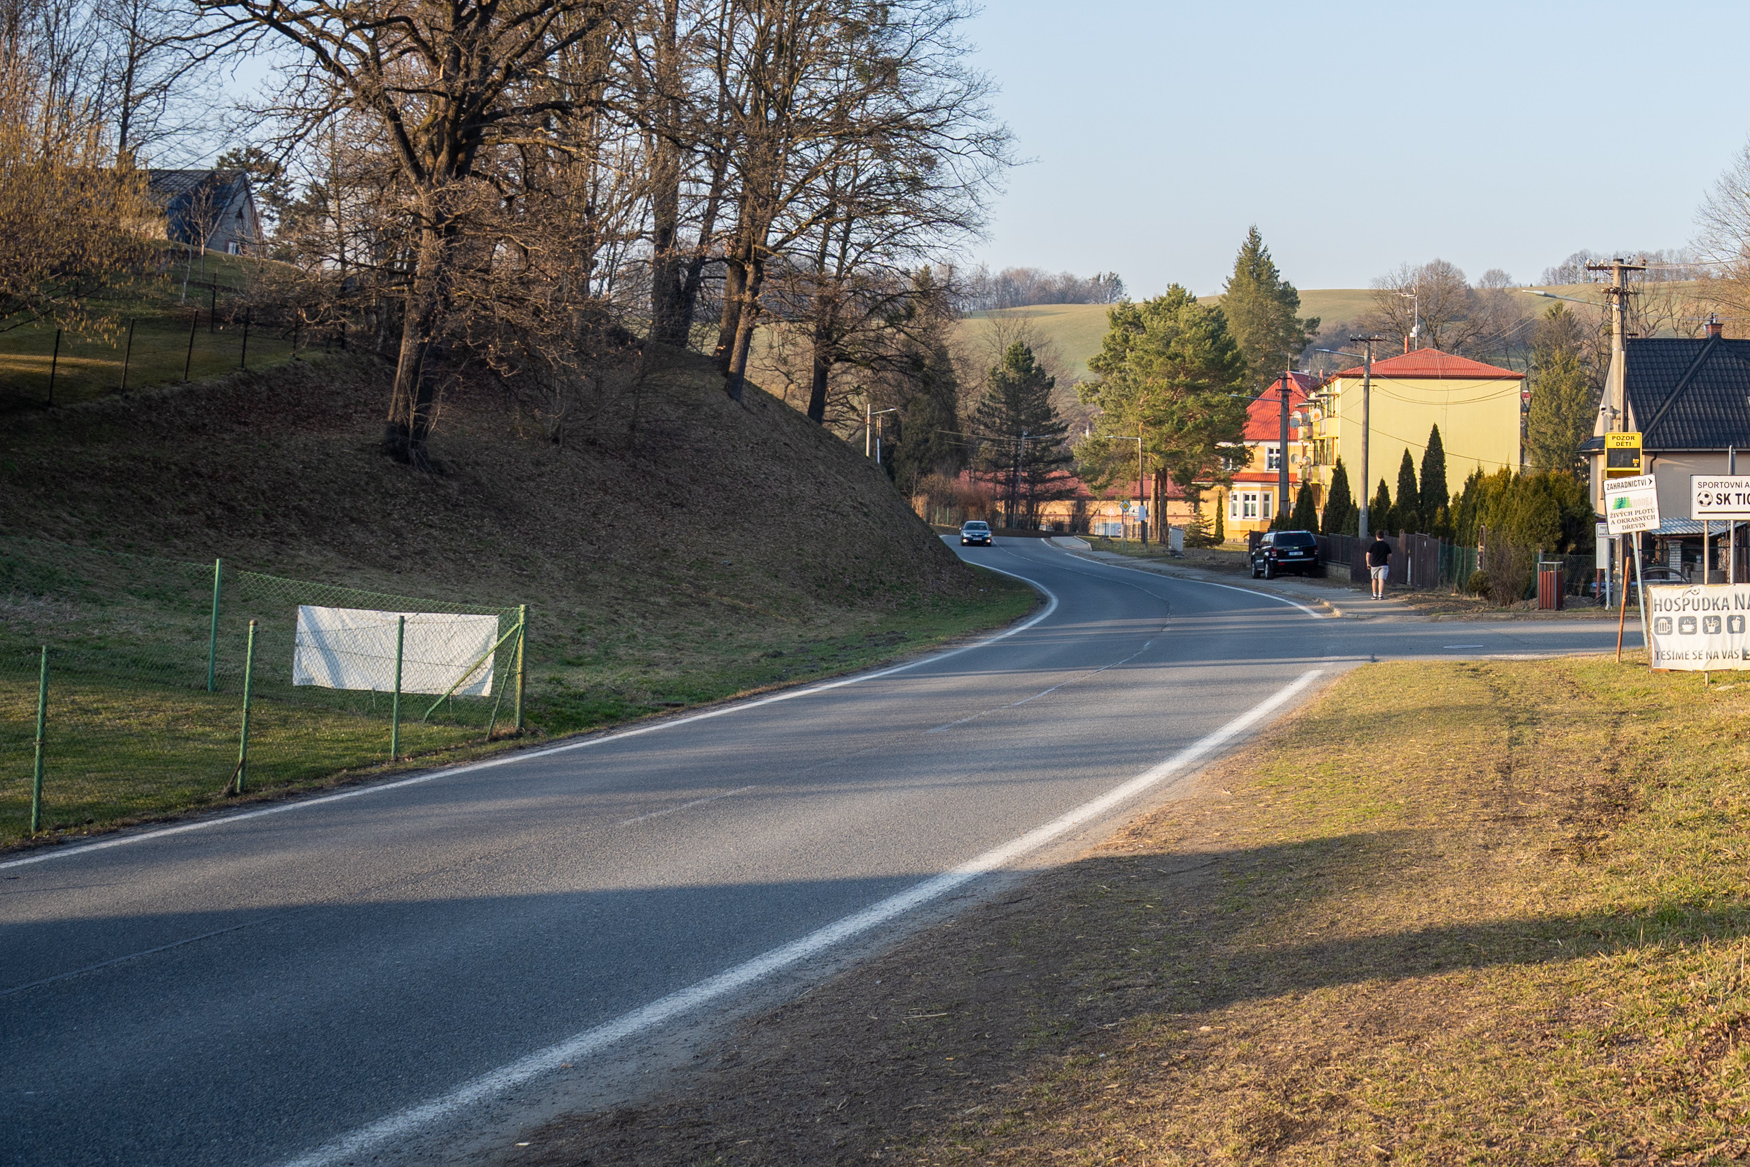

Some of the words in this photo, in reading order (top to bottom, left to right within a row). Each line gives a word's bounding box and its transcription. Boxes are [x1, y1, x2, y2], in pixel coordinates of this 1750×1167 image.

[1697, 480, 1743, 489] SPORTOVNÍ
[1715, 493, 1732, 506] SK
[1692, 649, 1704, 660] SE
[1705, 649, 1719, 660] NA
